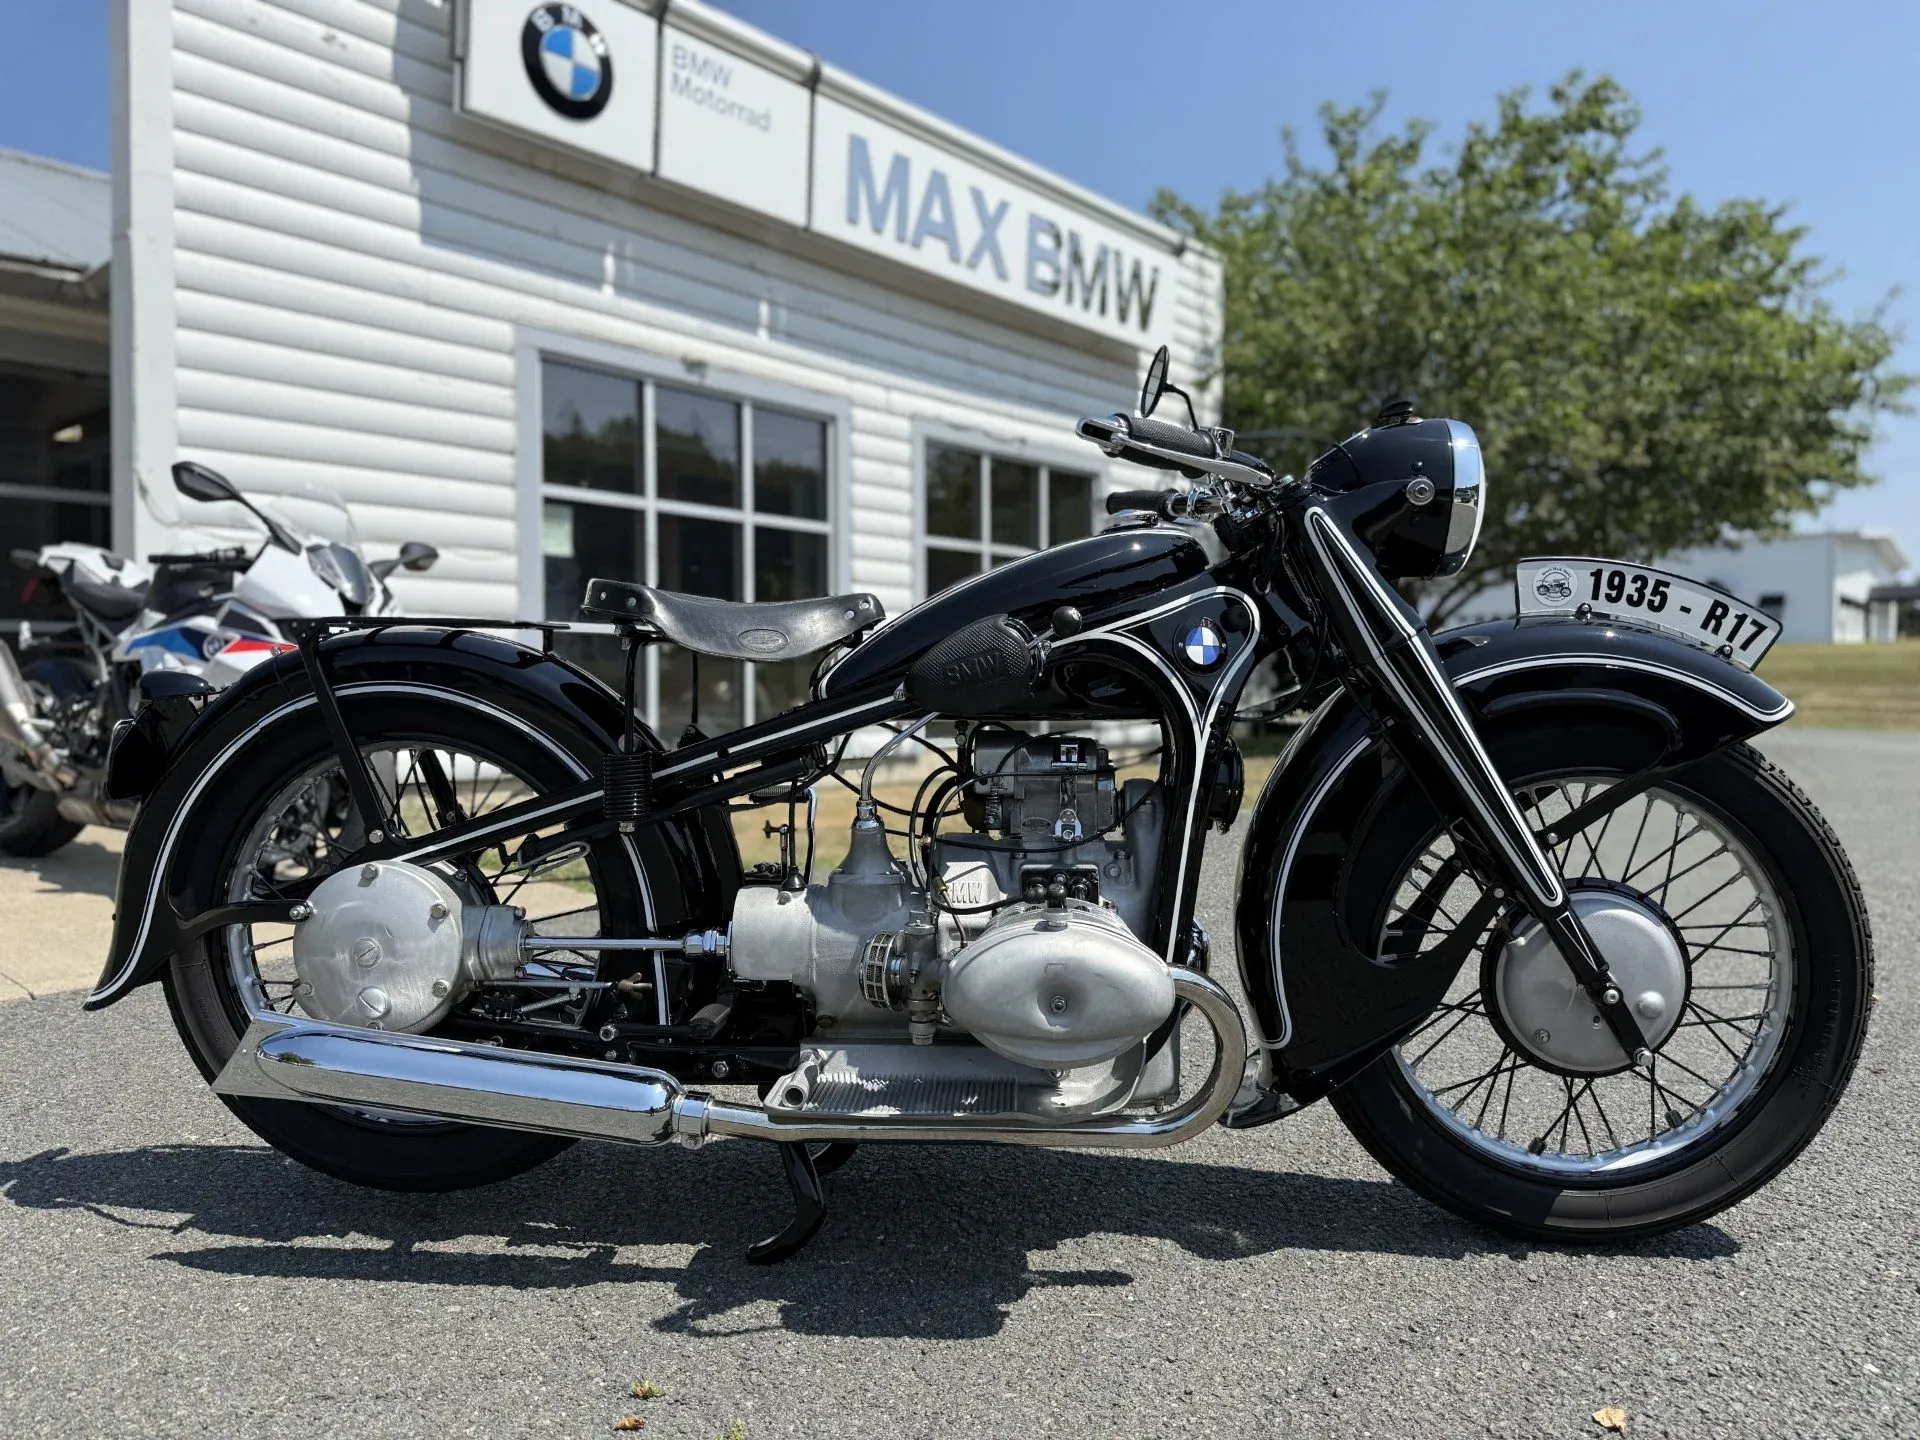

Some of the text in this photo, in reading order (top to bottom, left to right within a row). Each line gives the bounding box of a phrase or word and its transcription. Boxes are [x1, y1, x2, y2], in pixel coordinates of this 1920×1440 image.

[672, 44, 732, 88] BMW
[670, 71, 771, 132] Motorrad
[846, 132, 1160, 332] MAX BMW
[1590, 568, 1768, 652] 1935 - R17
[947, 882, 982, 904] MW
